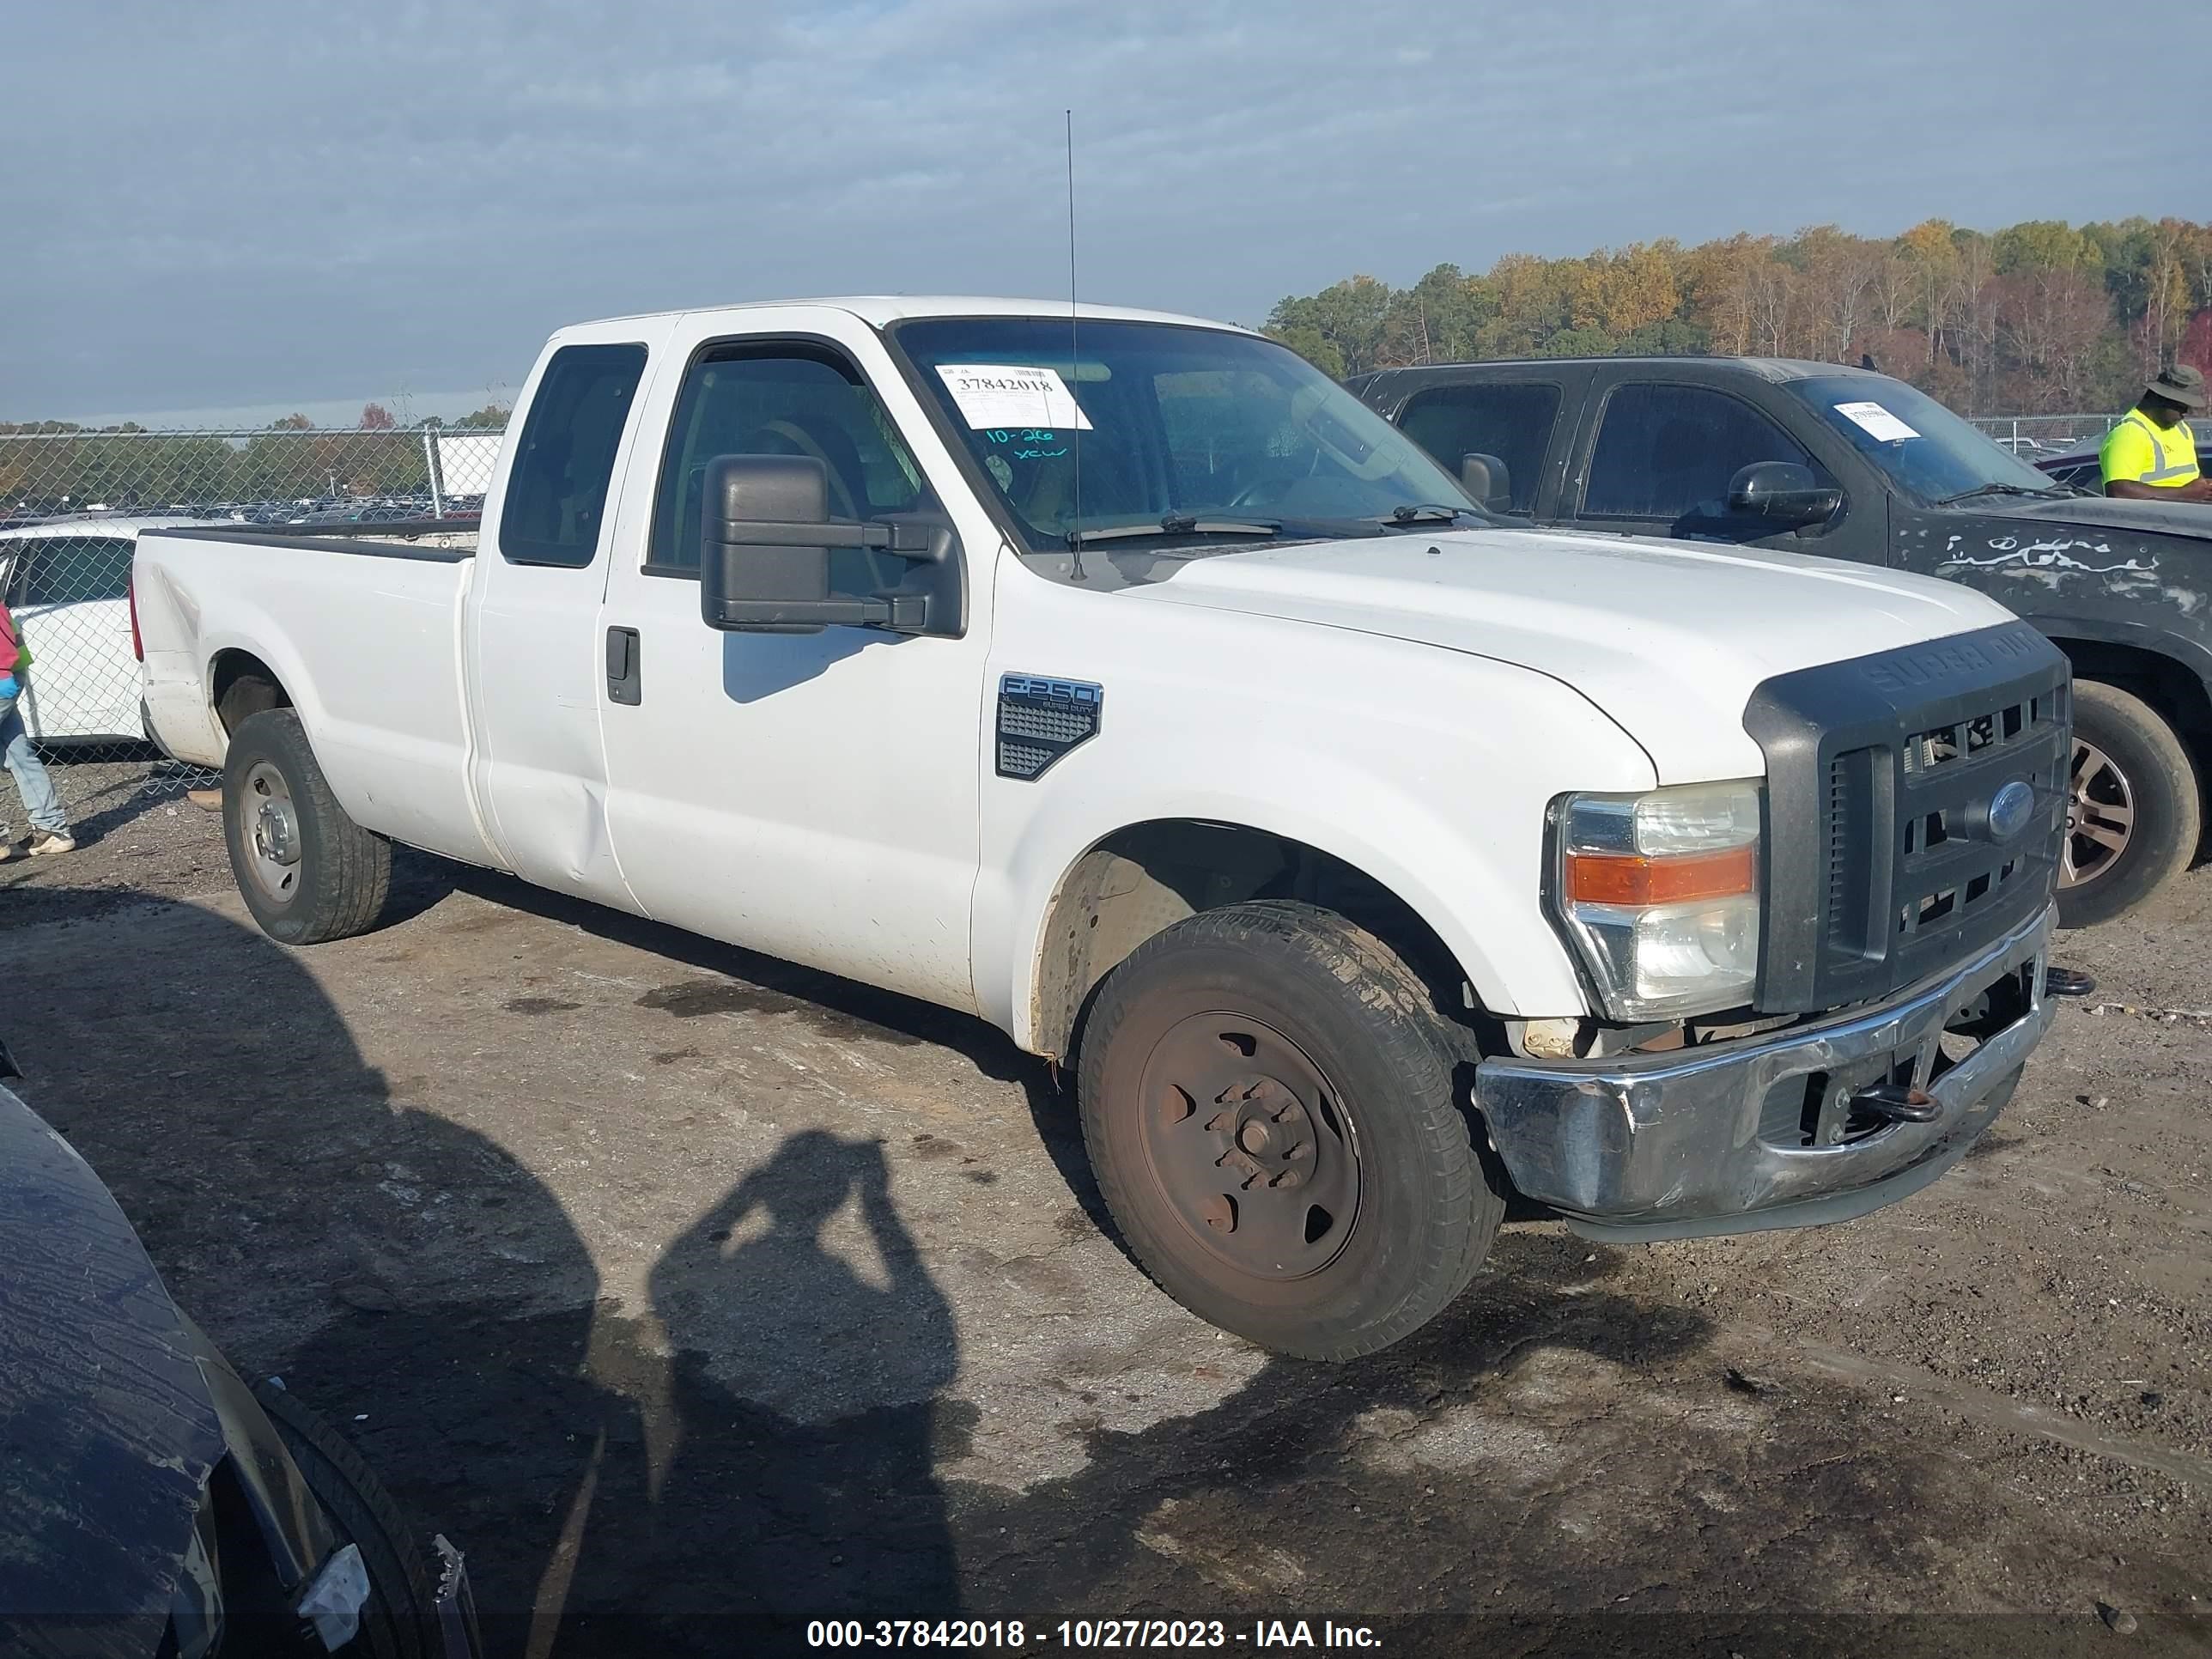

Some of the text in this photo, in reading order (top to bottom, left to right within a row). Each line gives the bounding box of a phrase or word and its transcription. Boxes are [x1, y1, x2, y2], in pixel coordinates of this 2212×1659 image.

[957, 378, 1053, 392] 37842018
[1859, 646, 1993, 692] SUPER
[1003, 678, 1095, 707] F-250
[1042, 701, 1093, 714] SUPER DUTY
